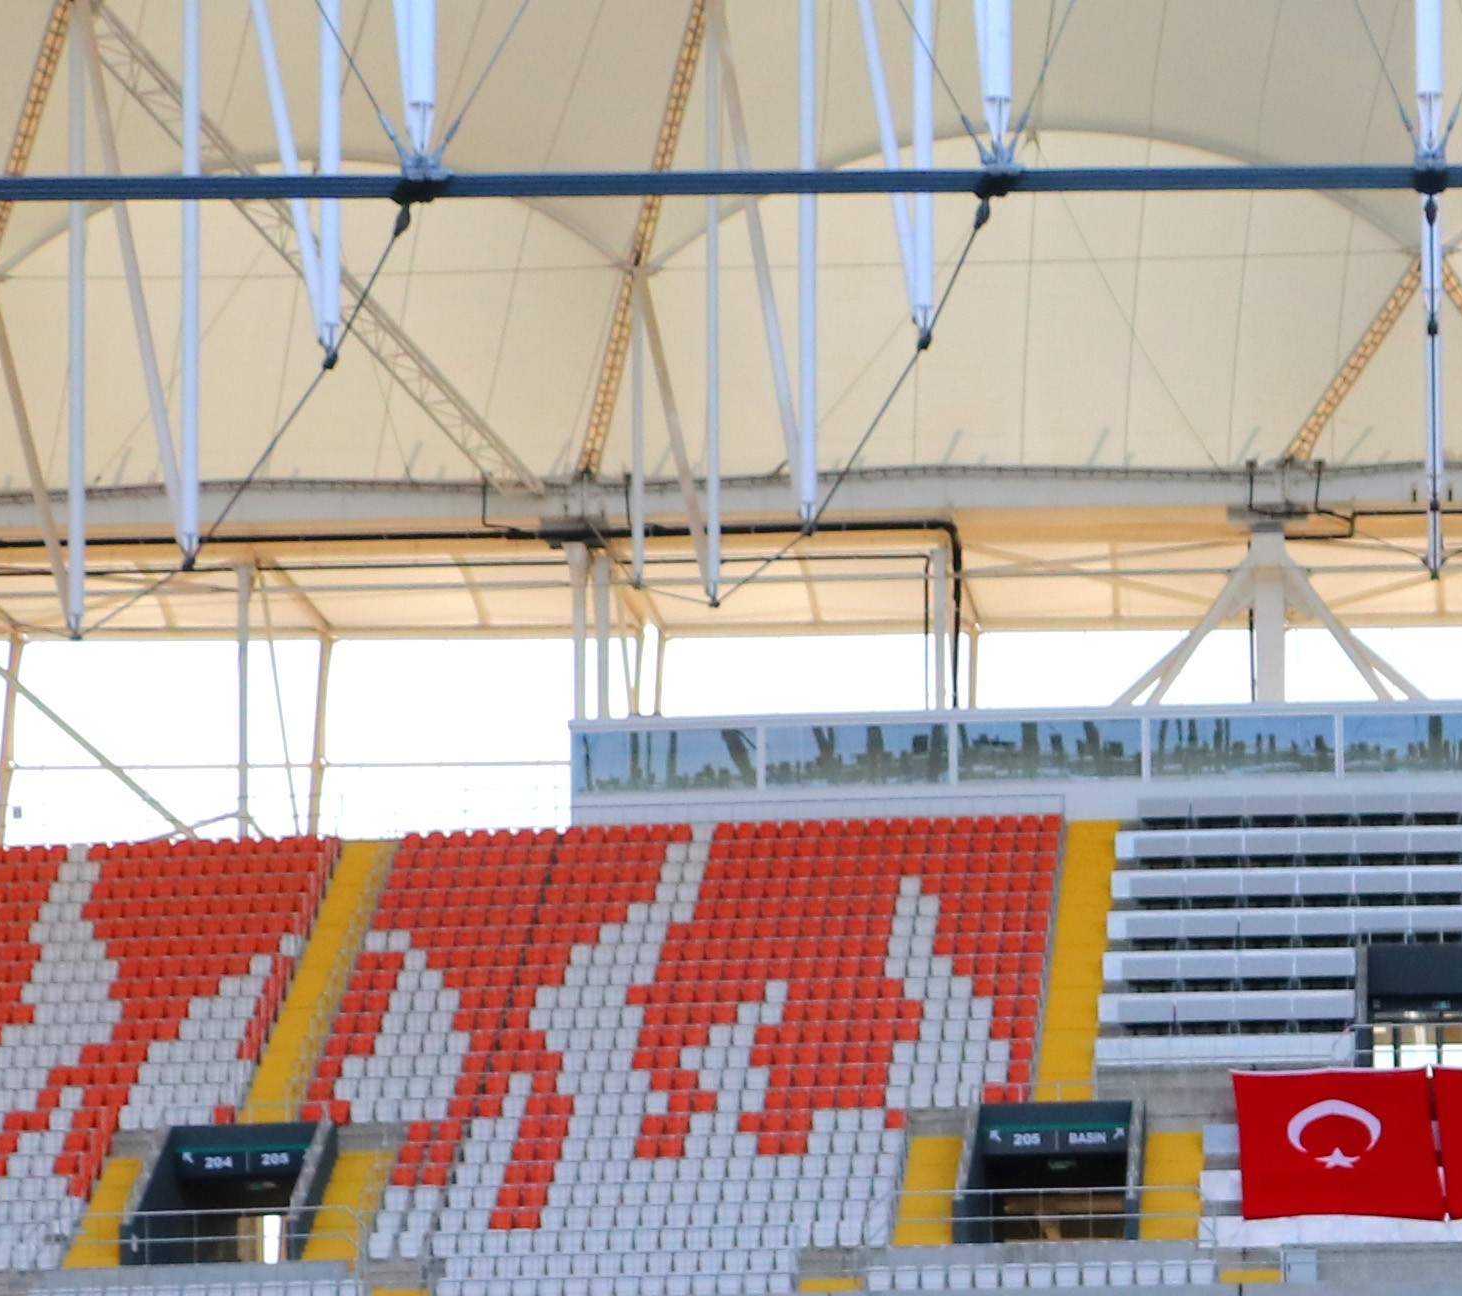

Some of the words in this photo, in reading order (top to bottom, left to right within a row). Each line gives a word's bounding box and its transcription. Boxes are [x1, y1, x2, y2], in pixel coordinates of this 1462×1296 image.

[1013, 1132, 1040, 1146] 205
[1068, 1132, 1107, 1145] BASIN
[204, 1156, 232, 1169] 204
[261, 1152, 290, 1166] 205
